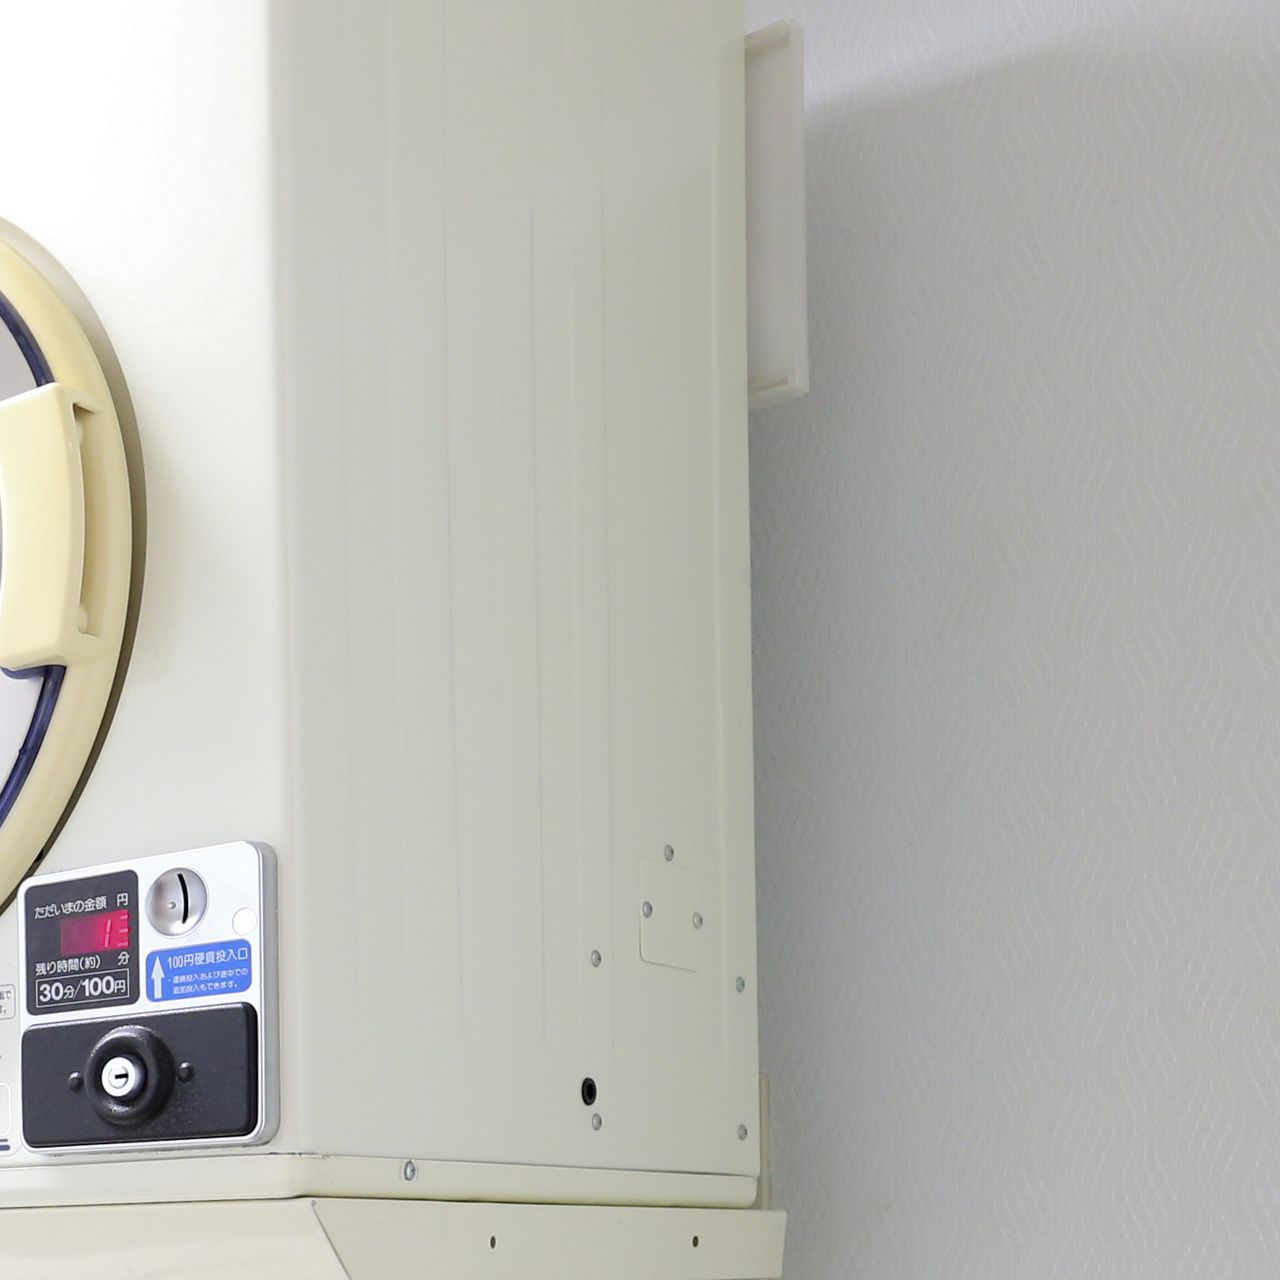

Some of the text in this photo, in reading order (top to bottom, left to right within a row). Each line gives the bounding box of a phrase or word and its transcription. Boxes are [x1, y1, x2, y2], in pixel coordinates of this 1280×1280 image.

[33, 893, 129, 919] ただいまの金額 円
[35, 951, 130, 976] 残り時間(約) 分
[167, 947, 248, 969] 100円硬貨投入口
[38, 976, 127, 1003] 30分/100円
